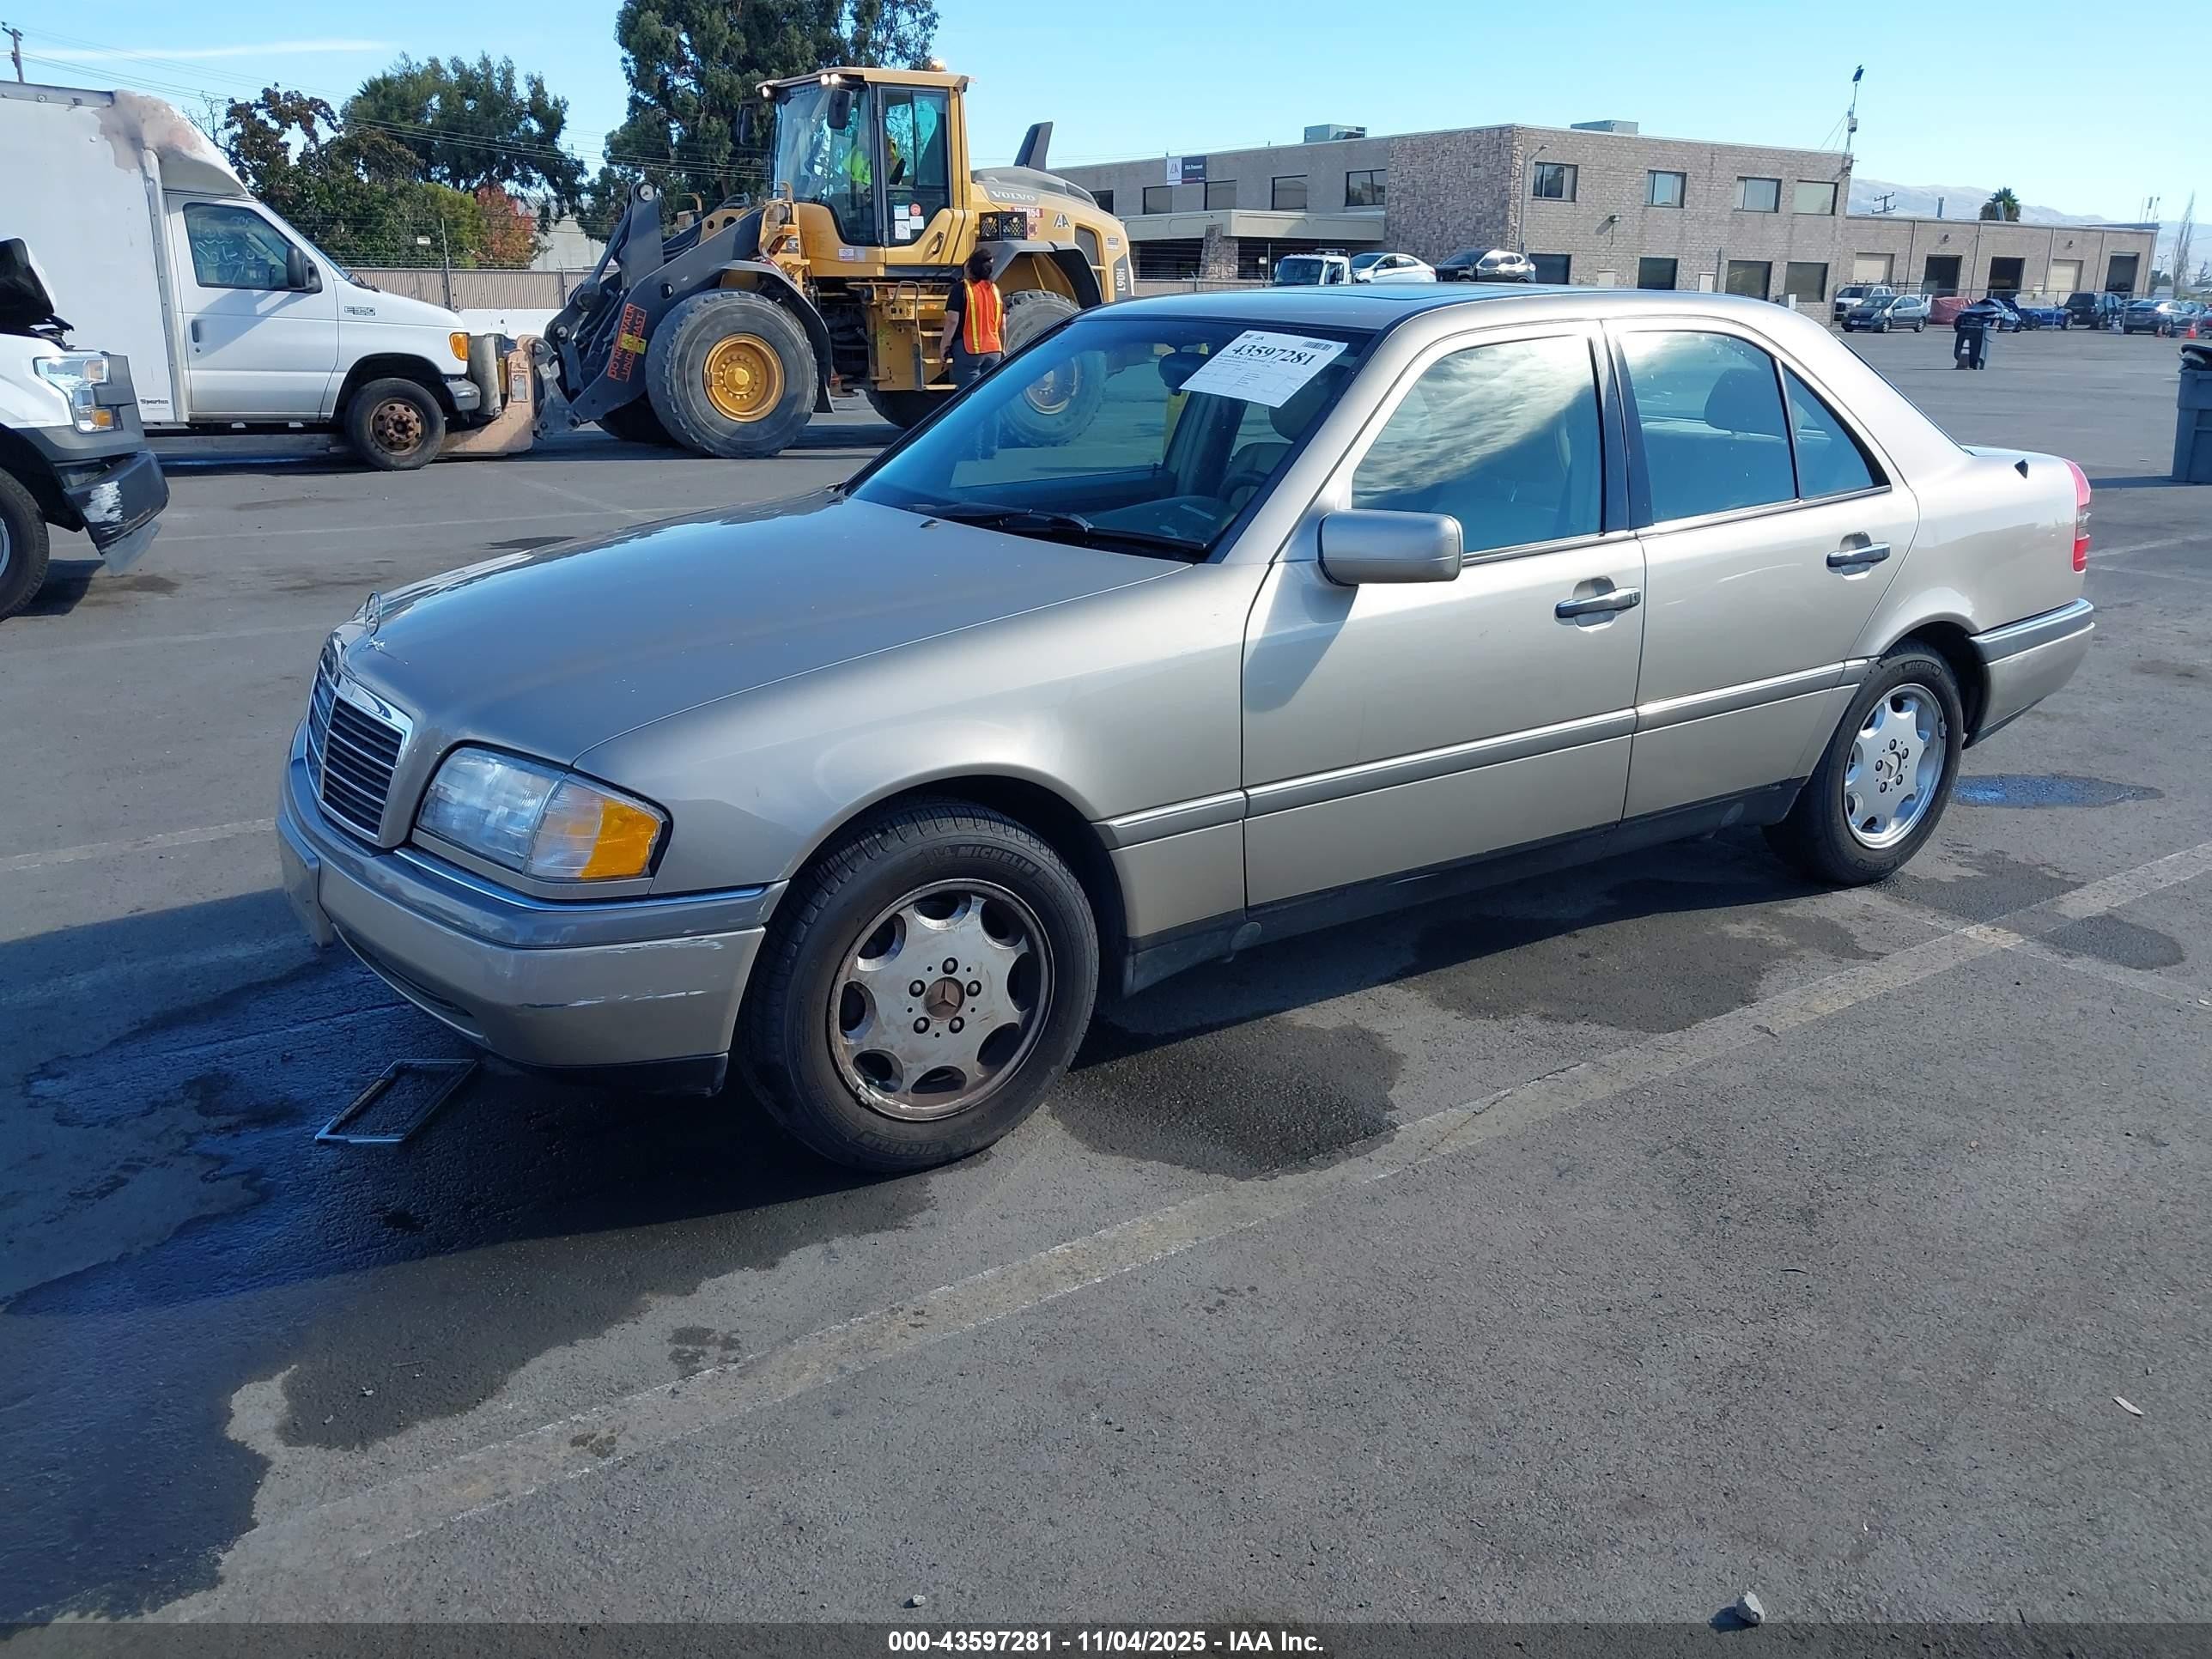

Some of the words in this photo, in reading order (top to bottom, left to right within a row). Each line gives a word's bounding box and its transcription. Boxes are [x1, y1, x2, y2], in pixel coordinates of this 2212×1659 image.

[991, 191, 1036, 201] VOLVO
[1115, 268, 1127, 292] L90H
[610, 362, 619, 378] DO
[621, 306, 635, 333] WALK
[1232, 343, 1317, 366] 43597281
[956, 845, 1040, 875] MICHELIN
